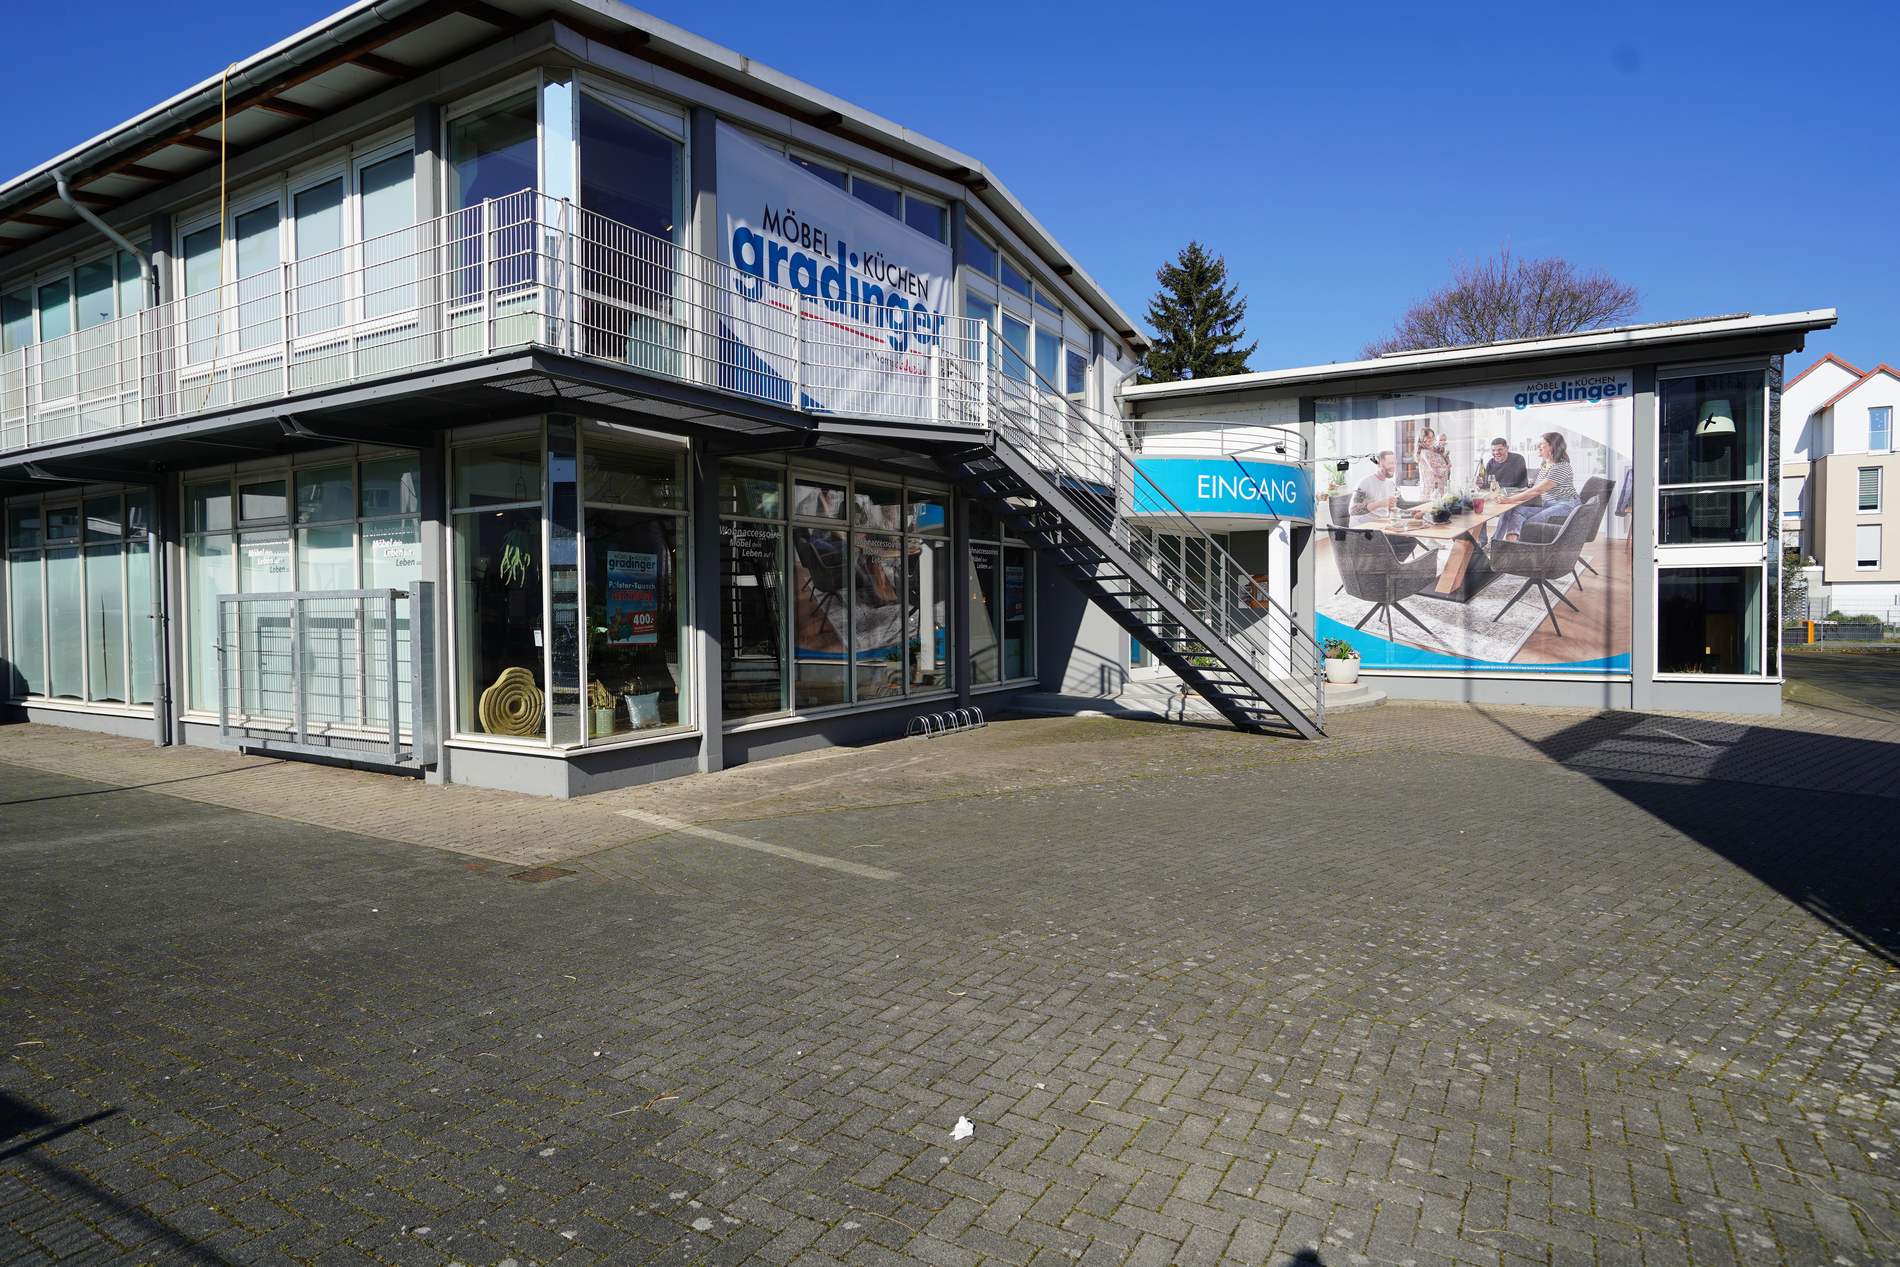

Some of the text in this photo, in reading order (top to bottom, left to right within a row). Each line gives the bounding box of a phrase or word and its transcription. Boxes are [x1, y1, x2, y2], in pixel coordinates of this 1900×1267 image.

[763, 203, 929, 300] MÖBEL KÜCHEN
[732, 226, 945, 352] gradinger
[1514, 381, 1628, 410] gradinger
[1527, 376, 1616, 391] MÖBEL KÜCHEN
[1197, 474, 1297, 504] EINGANG
[608, 555, 656, 572] gradinger
